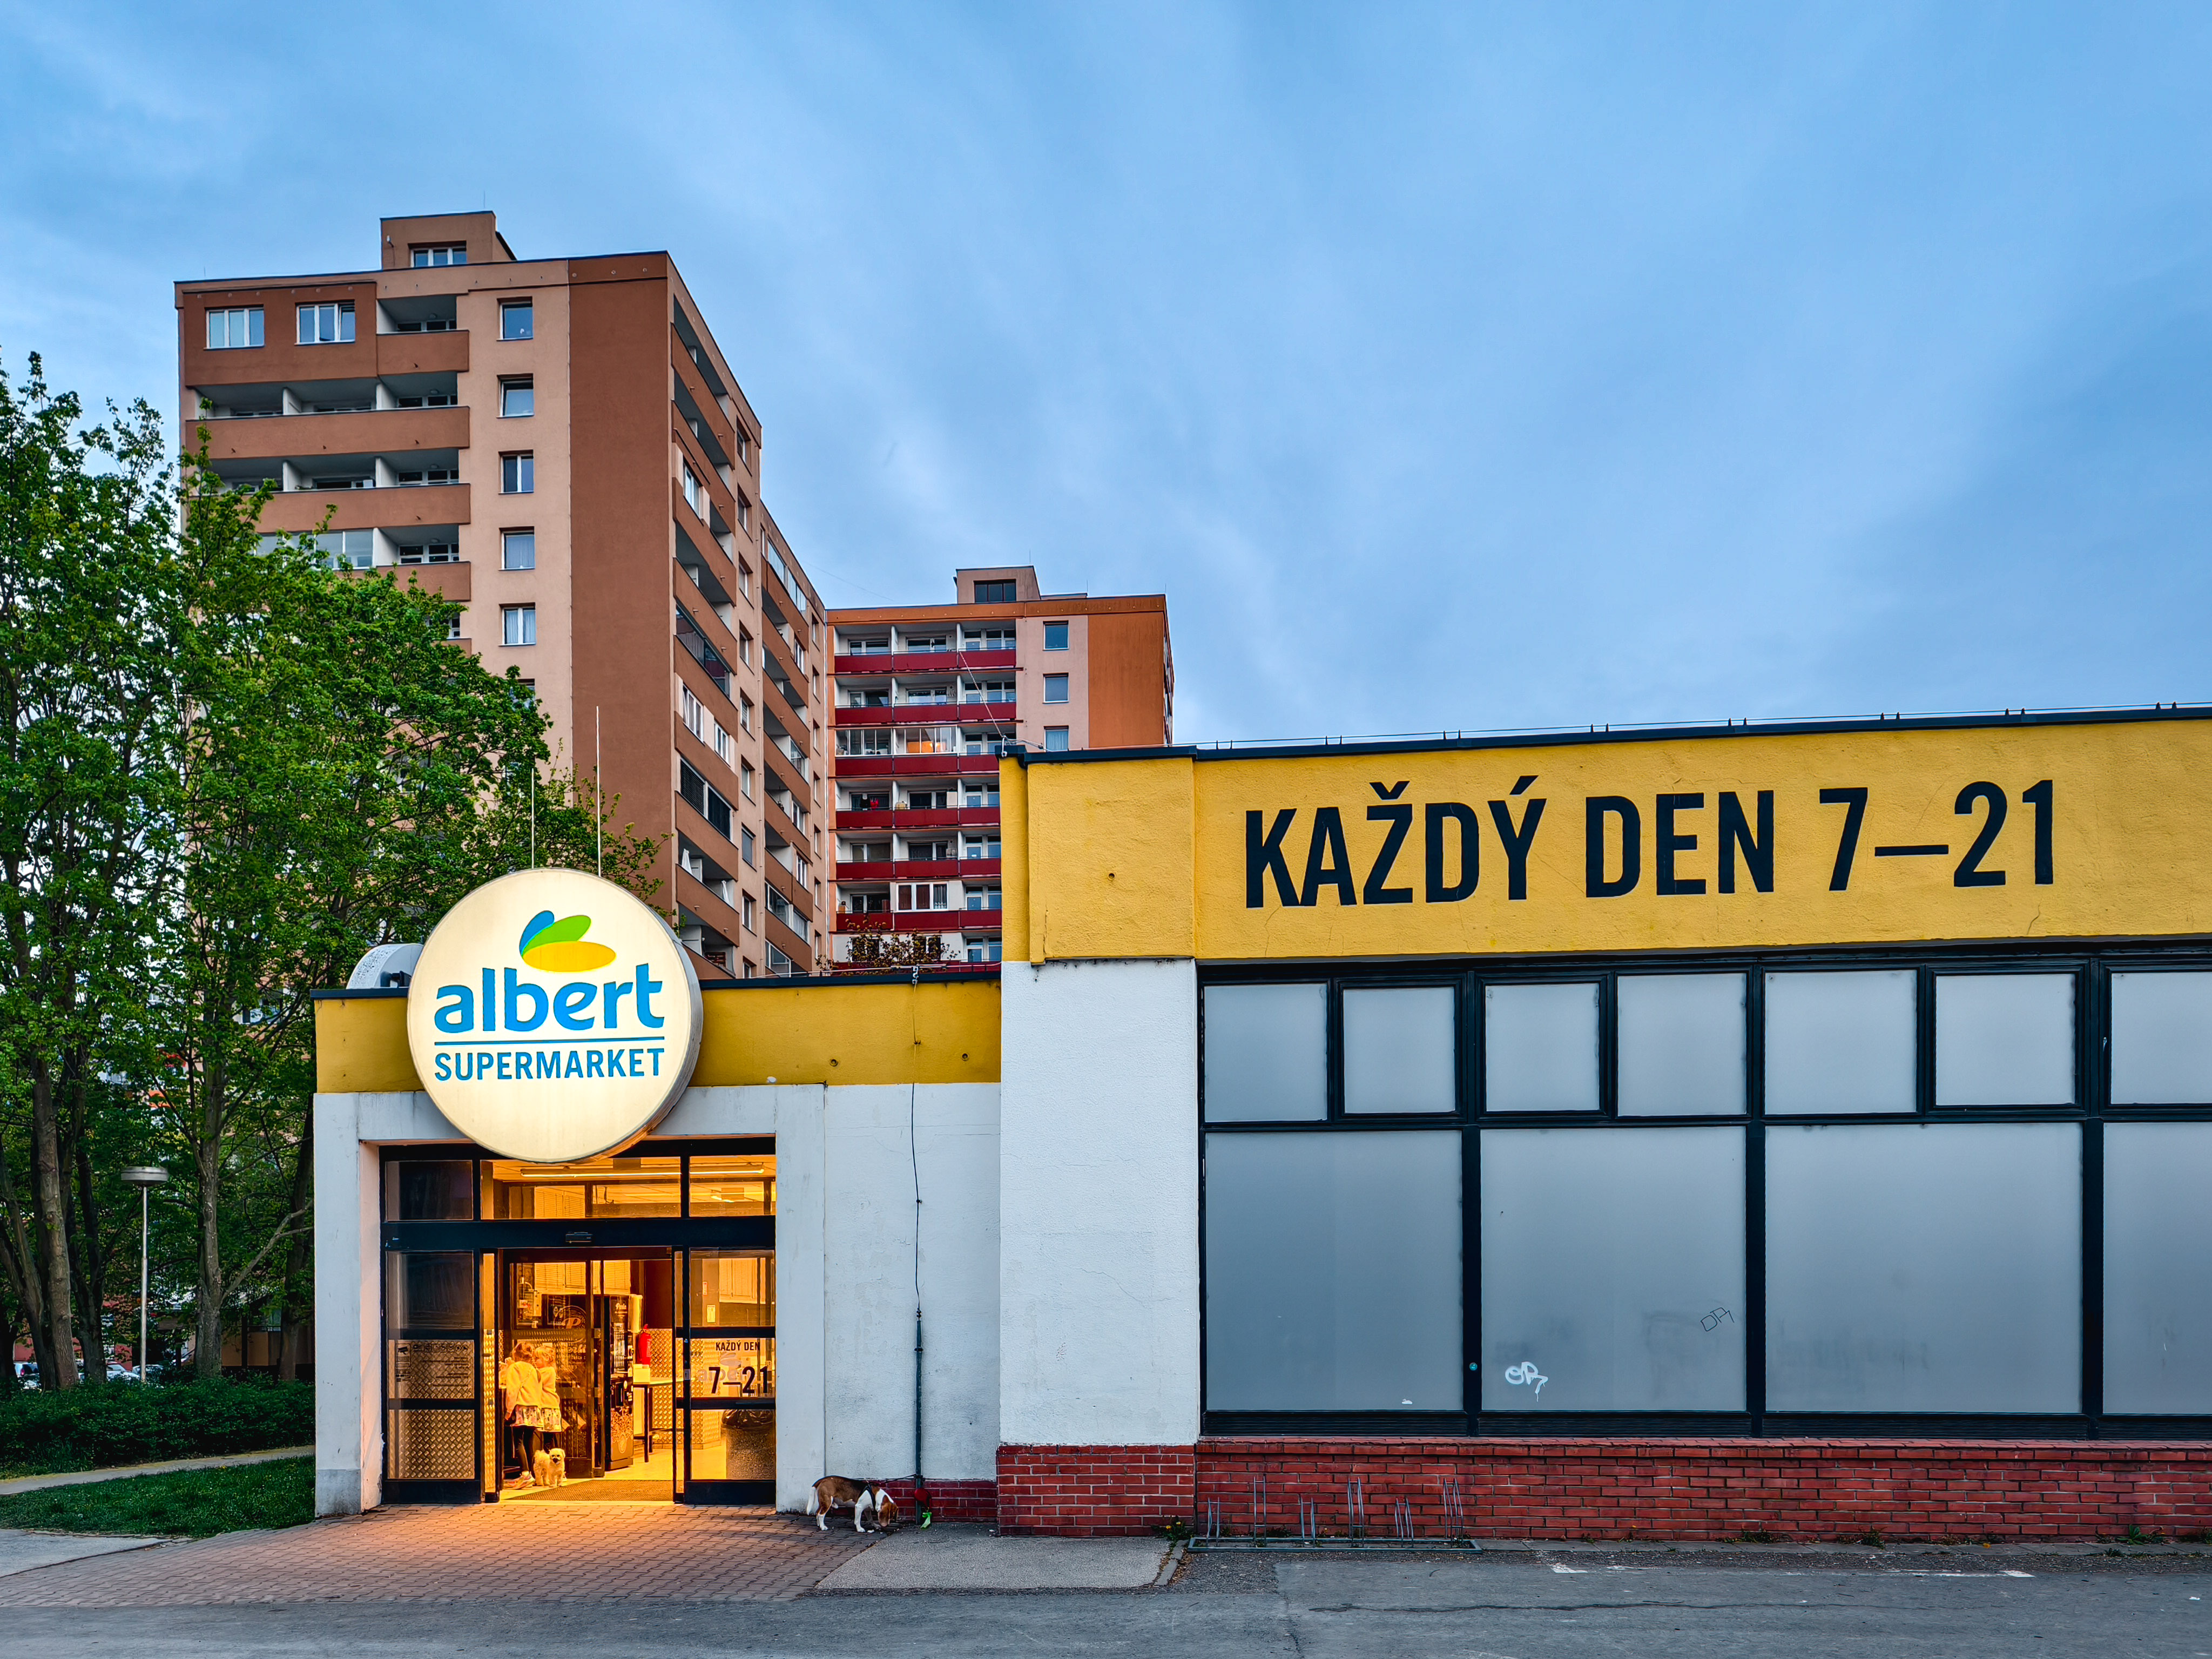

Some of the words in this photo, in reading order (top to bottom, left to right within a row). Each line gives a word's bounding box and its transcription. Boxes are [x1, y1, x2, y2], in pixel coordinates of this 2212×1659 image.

[1246, 775, 1547, 908] KAŽDÝ
[1586, 790, 1775, 898] DEN
[434, 962, 665, 1033] albert
[434, 1047, 665, 1081] SUPERMARKET
[716, 1340, 741, 1351] KAŽDÝ
[744, 1341, 760, 1351] DEN
